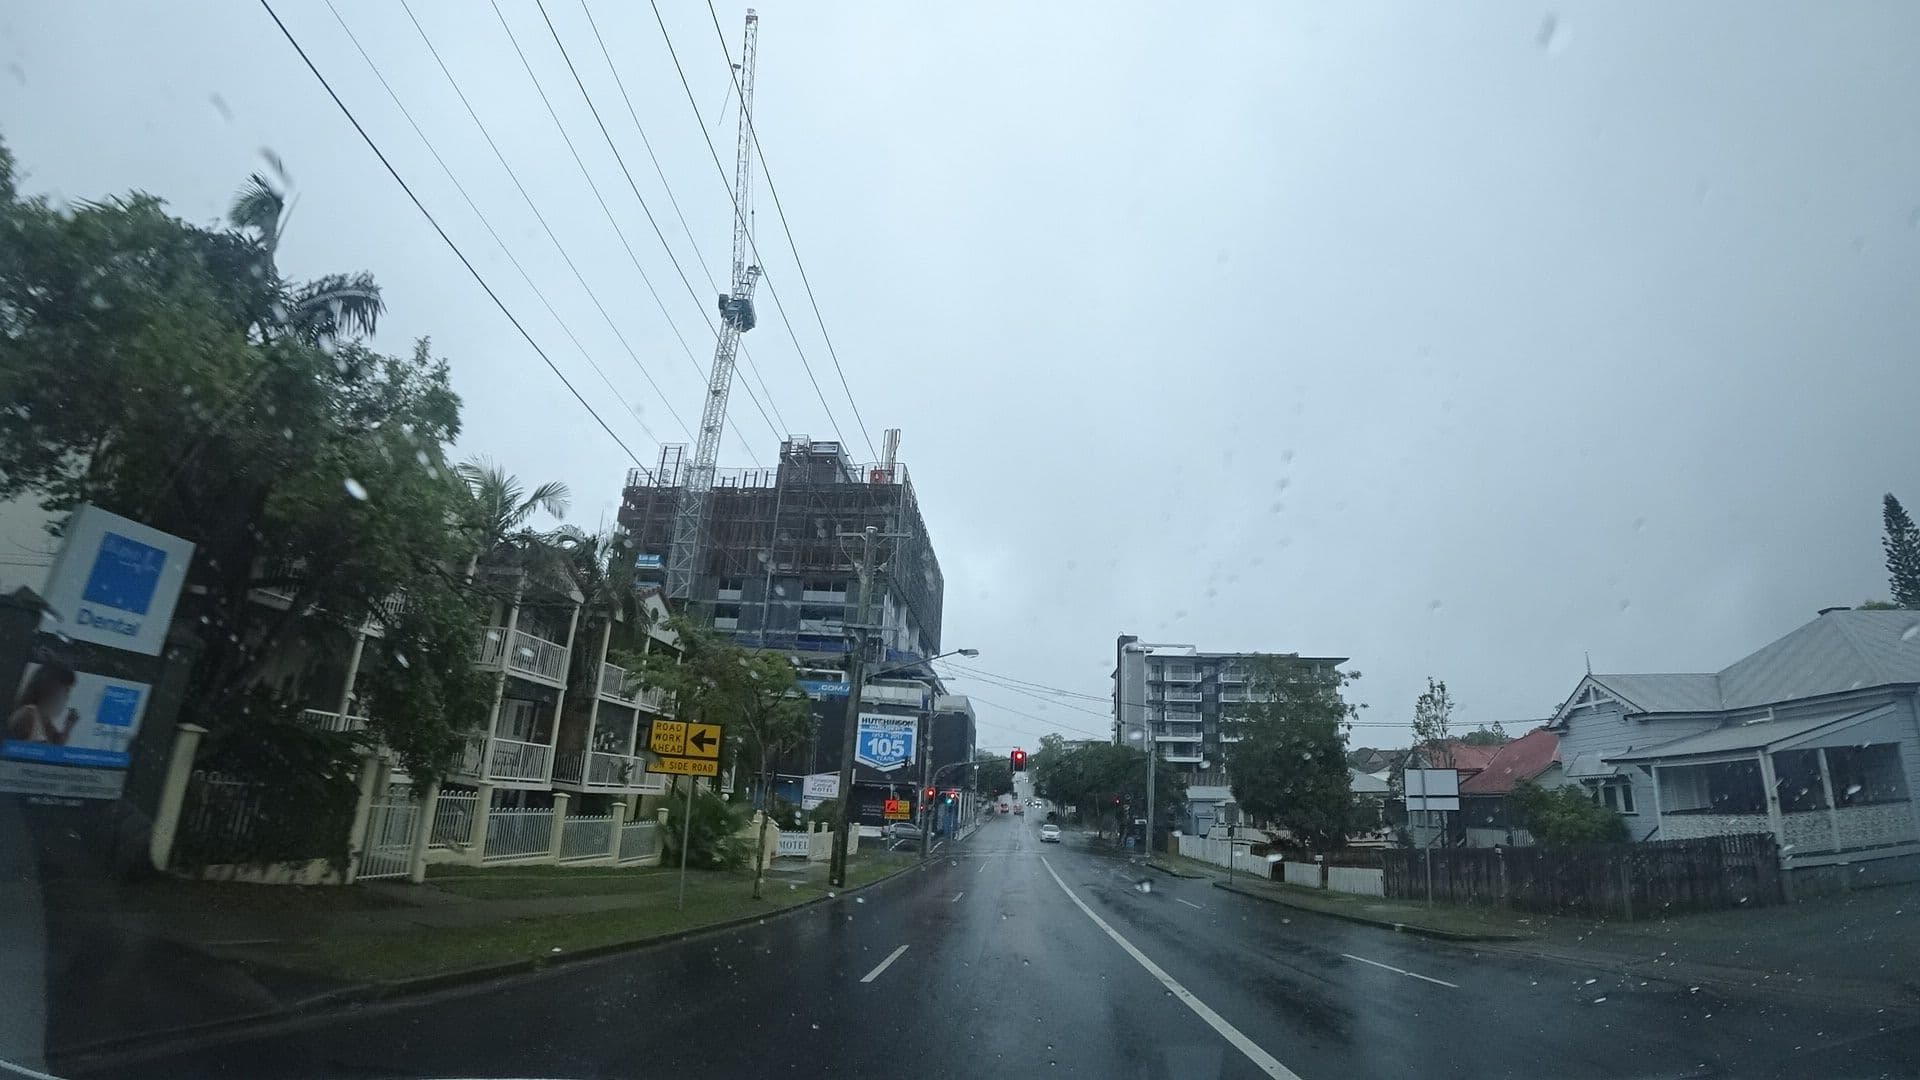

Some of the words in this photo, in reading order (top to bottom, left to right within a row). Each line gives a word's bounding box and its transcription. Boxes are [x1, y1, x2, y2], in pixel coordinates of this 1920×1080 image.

[78, 607, 141, 637] Dental
[656, 722, 682, 732] ROAD
[655, 733, 681, 742] WORK
[652, 744, 683, 753] AHEAD
[867, 738, 905, 757] 105
[653, 760, 665, 768] ON
[669, 761, 688, 770] SIDE
[692, 763, 714, 772] ROAD
[779, 840, 808, 850] MOTEL
